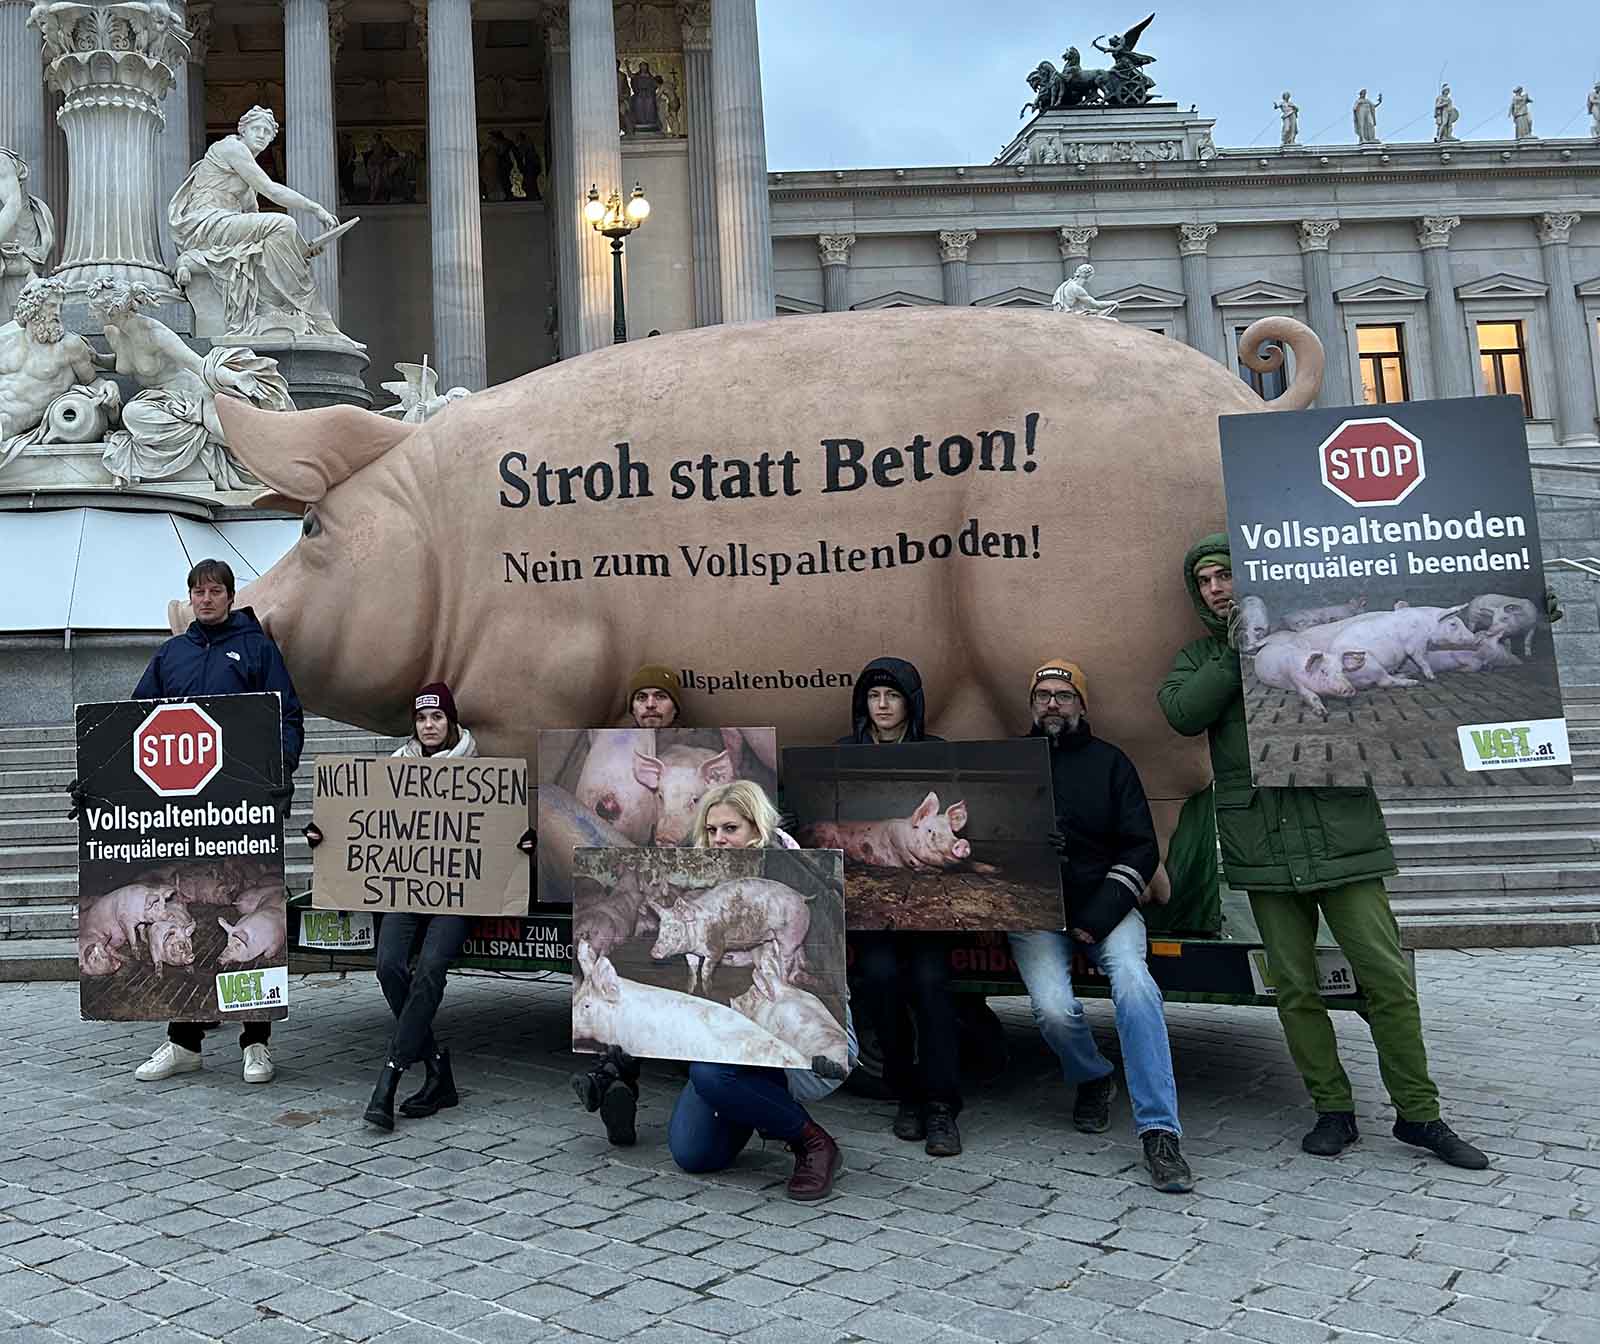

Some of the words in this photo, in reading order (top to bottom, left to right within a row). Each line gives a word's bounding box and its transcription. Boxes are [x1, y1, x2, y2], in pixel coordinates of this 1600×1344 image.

[499, 442, 653, 508] Stroh
[670, 451, 801, 500] statt
[820, 412, 1040, 493] Beton!
[1329, 444, 1412, 480] STOP
[1240, 510, 1526, 552] Vollspaltenboden
[503, 551, 583, 583] Nein
[592, 553, 672, 577] zum
[678, 518, 1040, 585] Vollspaltenboden!
[1243, 554, 1398, 584] Tierquälerei
[1407, 548, 1530, 574] beenden!
[143, 732, 213, 767] STOP
[316, 758, 376, 797] NICHT
[387, 764, 527, 806] VERGESSEN
[86, 800, 275, 834] Vollspaltenboden
[347, 810, 485, 844] SCHWEINE
[86, 837, 189, 863] Tierquälerei
[195, 834, 276, 856] beenden!
[347, 844, 482, 880] BRAUCHEN
[363, 876, 464, 907] STROH
[463, 940, 575, 959] OLLSPALTENBO
[526, 926, 559, 941] ZUM
